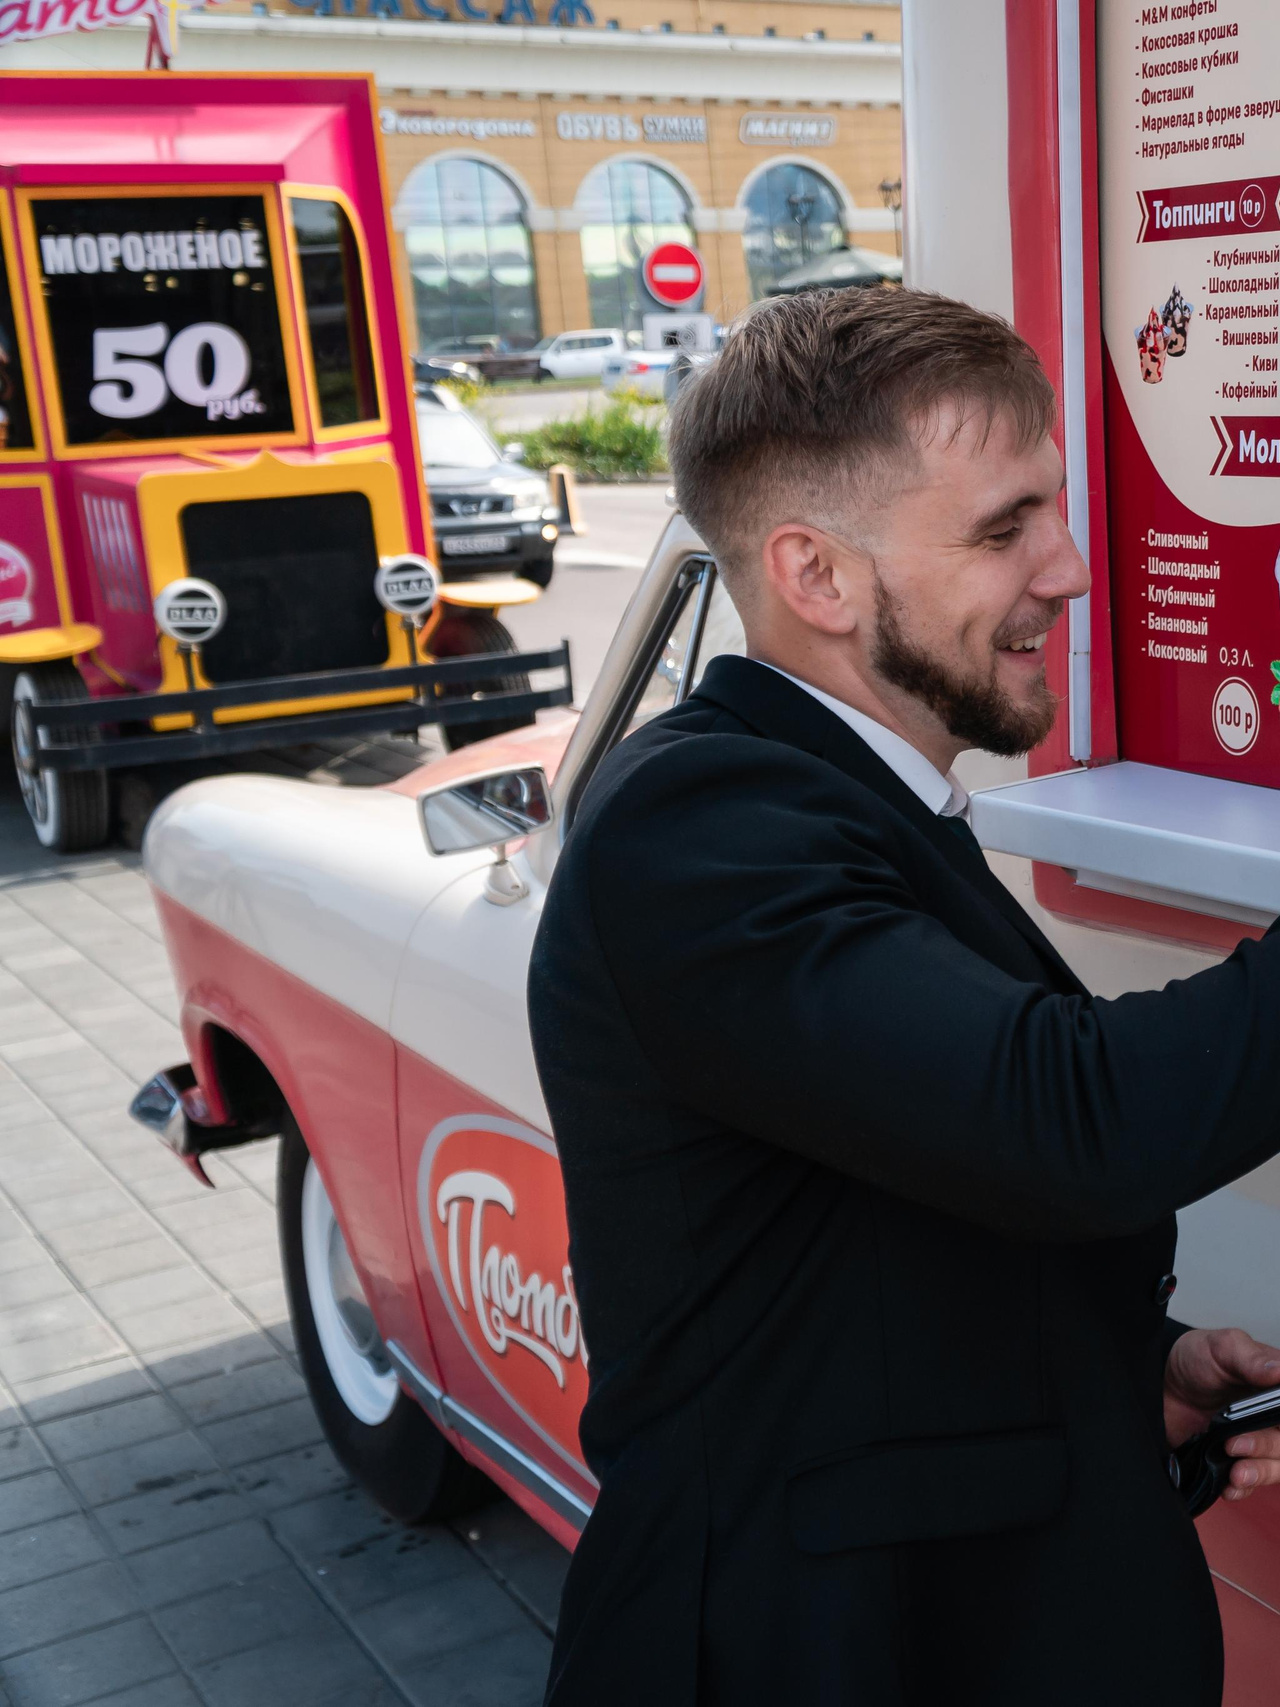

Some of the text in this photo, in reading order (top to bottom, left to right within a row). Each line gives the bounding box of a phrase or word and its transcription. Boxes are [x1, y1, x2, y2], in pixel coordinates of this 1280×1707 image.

[1171, 0, 1217, 20] конфеты
[1142, 22, 1239, 52] Кокосовая крошка
[1142, 50, 1239, 79] Кокосовые кубики
[1142, 85, 1194, 106] Фисташки
[557, 111, 640, 141] ОБУВЬ
[1142, 112, 1195, 134] Мармелад
[1206, 105, 1241, 126] форме
[1142, 132, 1245, 160] Натуральные ягоды
[1152, 195, 1235, 230] Топпинги
[1242, 198, 1253, 216] 10
[40, 229, 264, 275] МОРОЖЕНОЕ
[1213, 245, 1280, 268] Клубничный
[1208, 272, 1279, 295] Шоколадный
[1205, 300, 1279, 324] Карамельный
[1222, 325, 1279, 347] Вишневый
[89, 321, 265, 422] 50 руб.
[1252, 355, 1278, 373] Киви
[1222, 380, 1278, 402] Кофейный
[1147, 529, 1209, 551] Сливочный
[1147, 558, 1220, 580] Шоколадный
[1147, 586, 1215, 608] Клубничный
[1147, 614, 1208, 636] Банановый
[1147, 641, 1207, 664] Кокосовый
[1219, 647, 1239, 667] 0,3
[1219, 704, 1241, 727] 100
